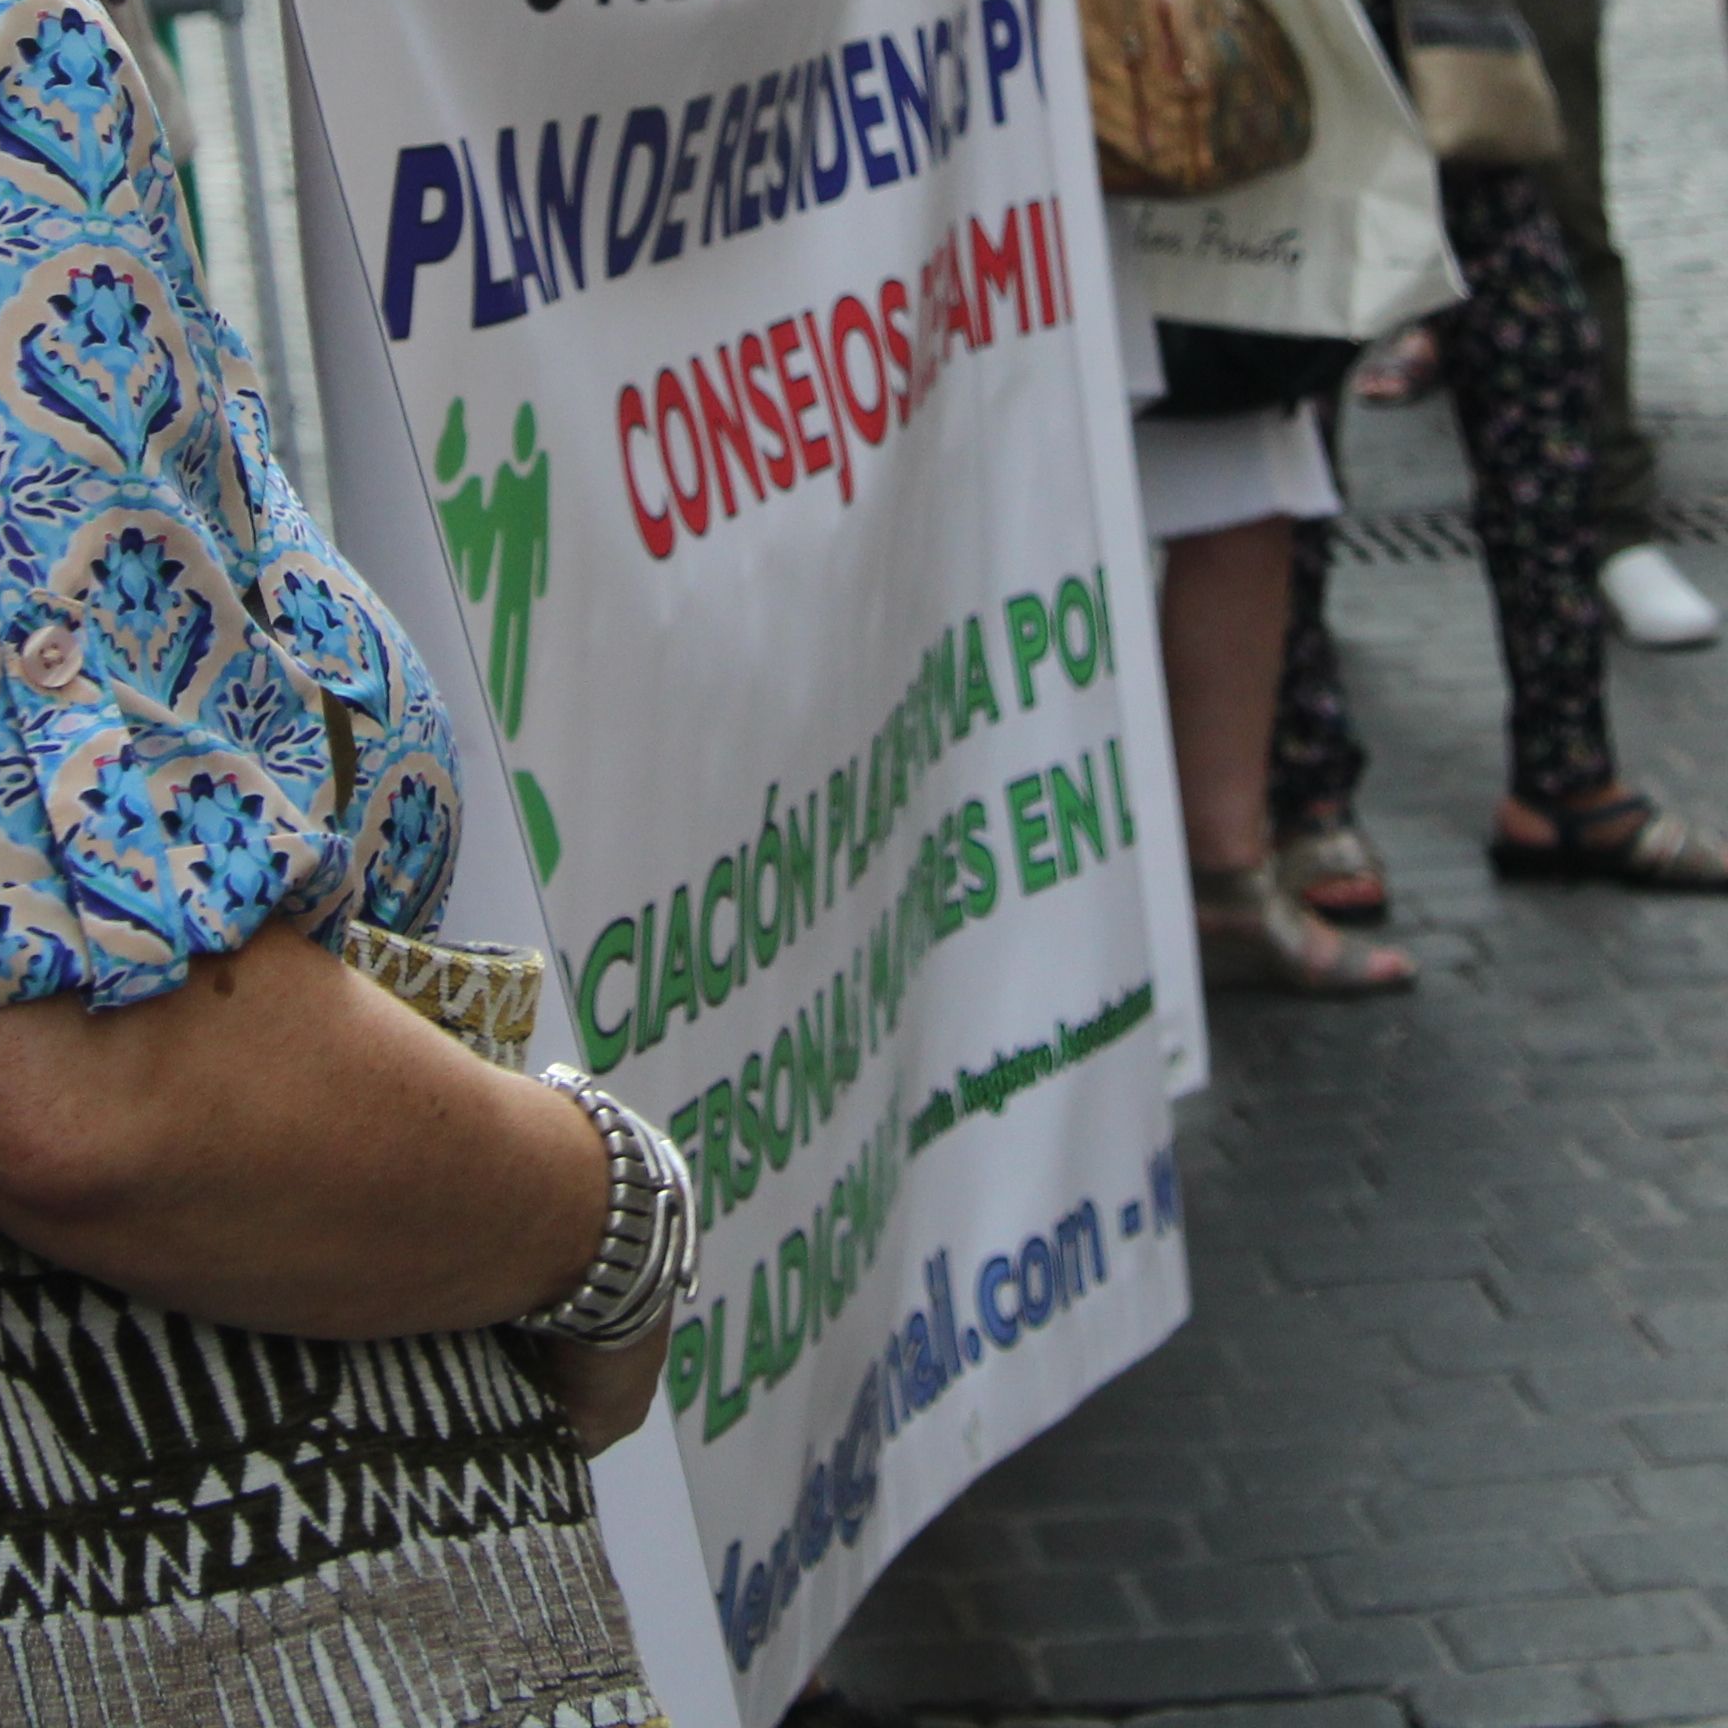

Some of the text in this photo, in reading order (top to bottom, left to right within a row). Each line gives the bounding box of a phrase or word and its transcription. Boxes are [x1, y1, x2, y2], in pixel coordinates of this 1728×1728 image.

[382, 114, 600, 341] PLAN
[605, 94, 714, 279] DE
[614, 279, 914, 560] CONSEJOS
[562, 781, 818, 1074] CIACIÓN
[1007, 752, 1106, 896] EN
